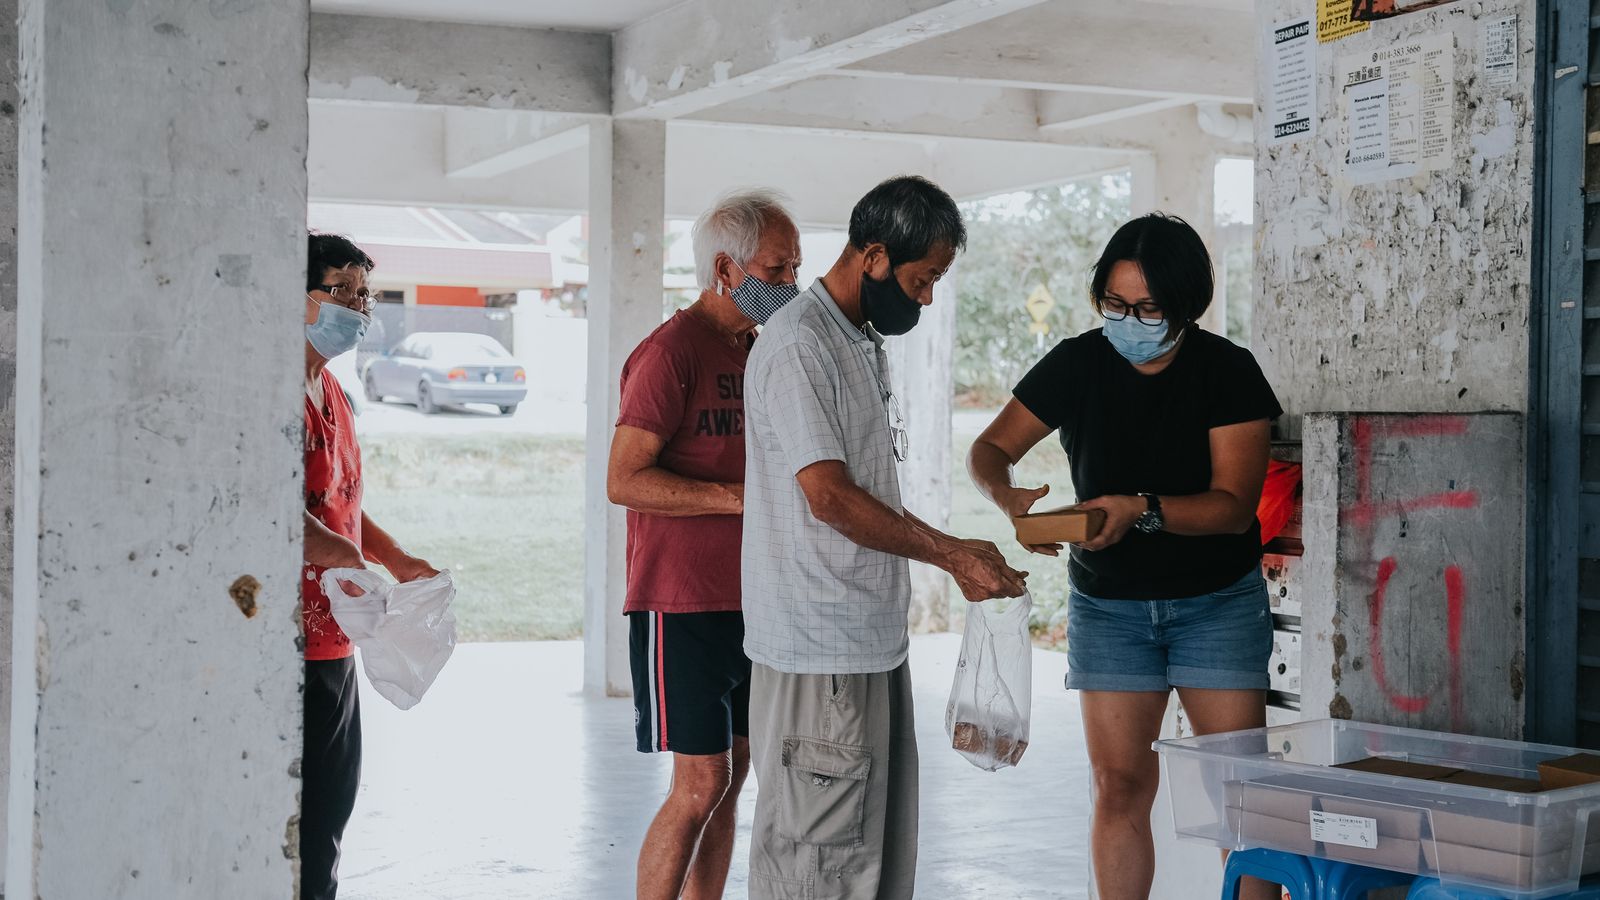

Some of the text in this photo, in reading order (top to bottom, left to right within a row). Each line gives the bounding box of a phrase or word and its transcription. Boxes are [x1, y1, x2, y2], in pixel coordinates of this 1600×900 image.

[1320, 14, 1348, 31] 017-775
[1275, 27, 1295, 42] REPAIR
[1379, 47, 1405, 61] 014-383
[1406, 45, 1421, 56] 3666
